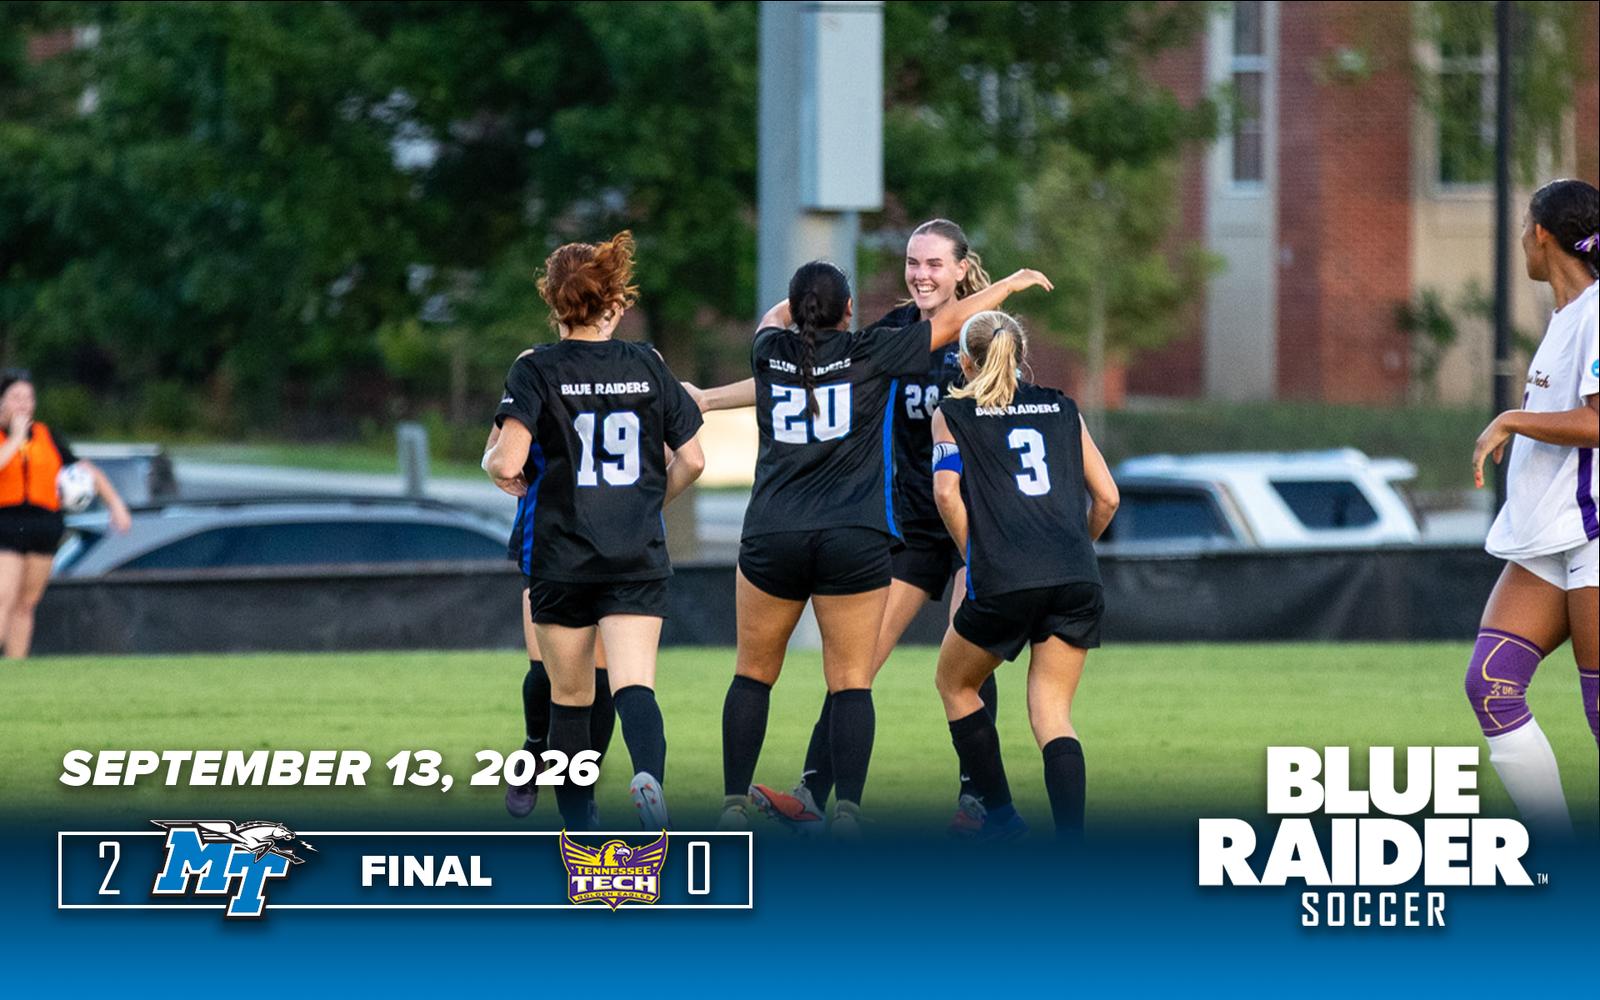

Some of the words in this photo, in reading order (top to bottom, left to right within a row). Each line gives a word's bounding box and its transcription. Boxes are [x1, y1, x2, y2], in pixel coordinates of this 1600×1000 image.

[560, 384, 592, 396] BLUE
[595, 381, 650, 395] RAIDERS
[771, 382, 852, 444] 20
[1007, 402, 1061, 416] RAIDERS
[573, 411, 640, 486] 19
[1007, 428, 1051, 496] 3
